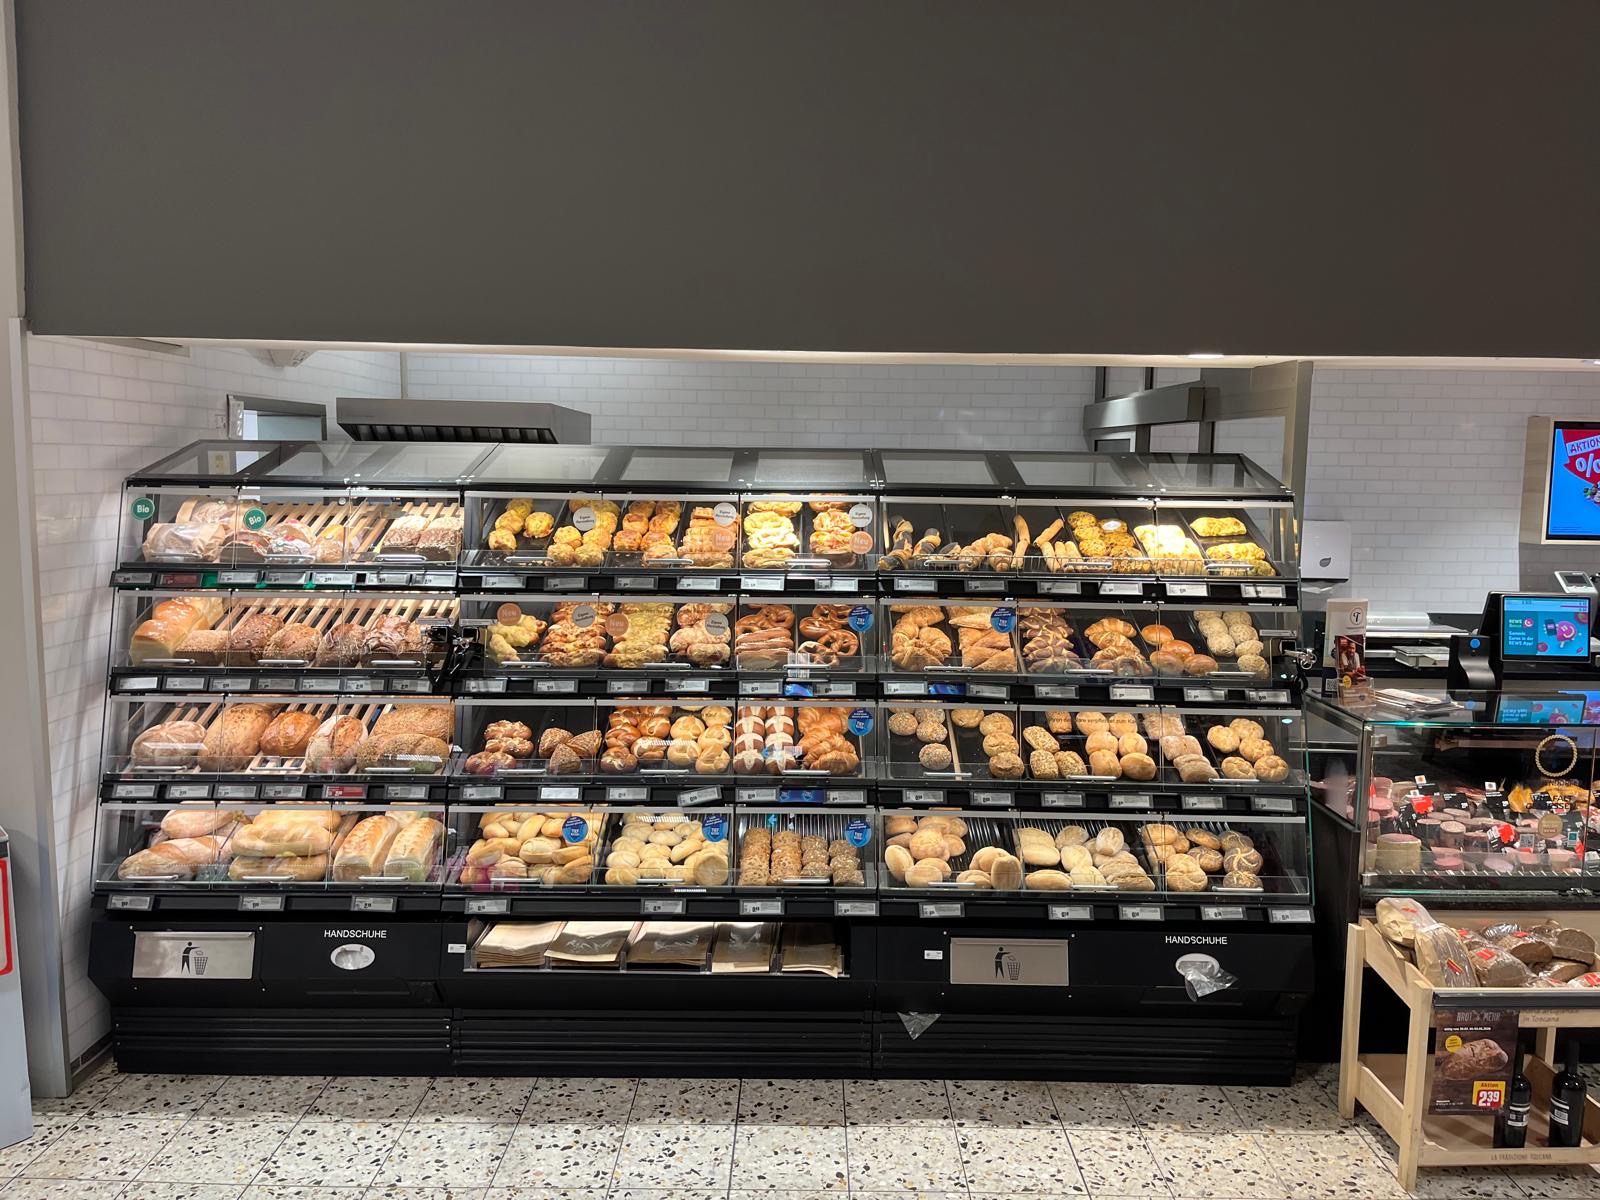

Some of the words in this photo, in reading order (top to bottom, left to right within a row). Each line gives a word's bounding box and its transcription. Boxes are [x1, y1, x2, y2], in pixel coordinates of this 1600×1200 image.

[136, 504, 150, 513] Bio
[248, 516, 262, 526] Bio
[323, 929, 387, 939] HANDSCHUHE
[1165, 935, 1228, 945] HANDSCHUHE
